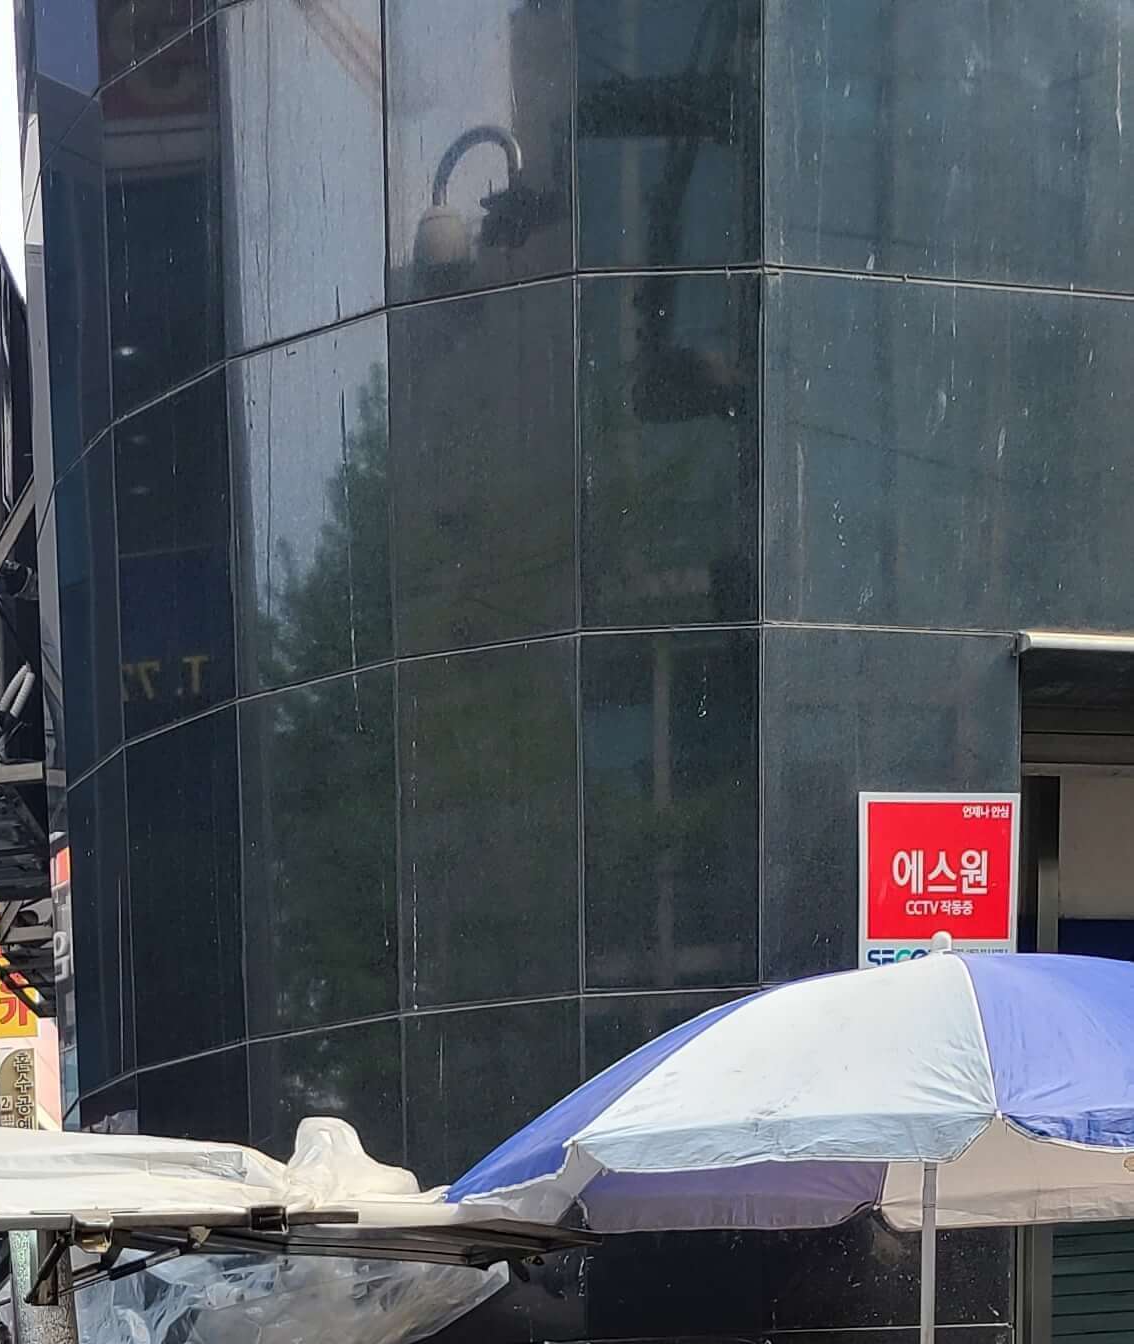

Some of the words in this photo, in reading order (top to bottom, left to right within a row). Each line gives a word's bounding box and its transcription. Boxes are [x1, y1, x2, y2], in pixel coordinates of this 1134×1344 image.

[962, 805, 990, 819] 언제나
[991, 805, 1010, 819] 안심
[892, 849, 989, 895] 에스원
[905, 900, 939, 916] CCTV
[940, 900, 974, 917] 작동중
